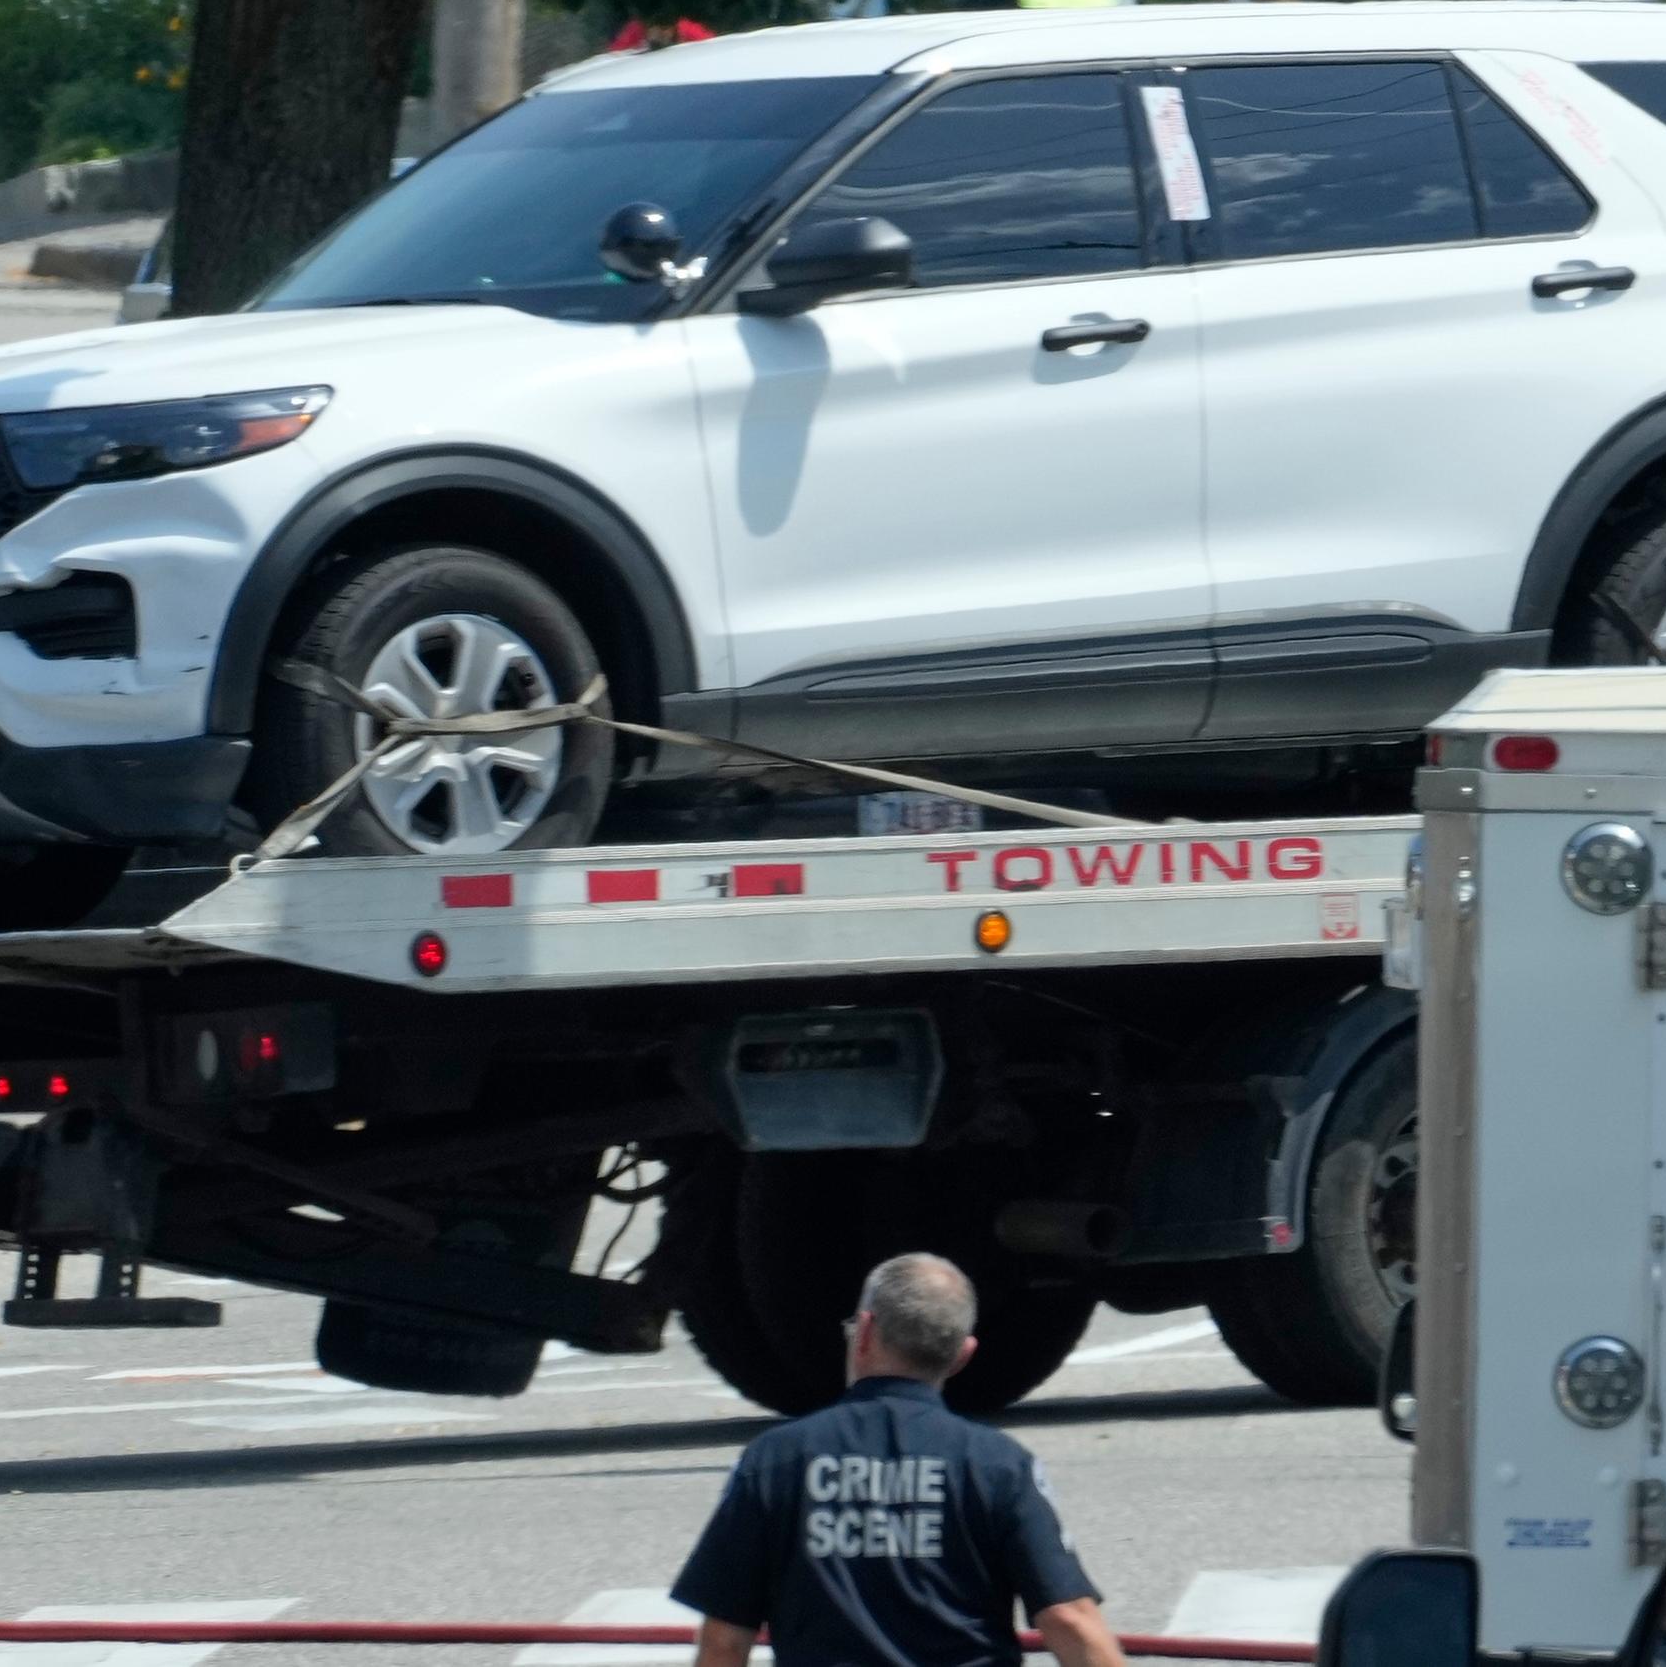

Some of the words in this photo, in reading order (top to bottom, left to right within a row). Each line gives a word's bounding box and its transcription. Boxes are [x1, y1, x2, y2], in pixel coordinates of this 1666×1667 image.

[927, 837, 1323, 891] TOWING
[806, 1455, 946, 1504] CRIME
[806, 1509, 943, 1558] SCENE
